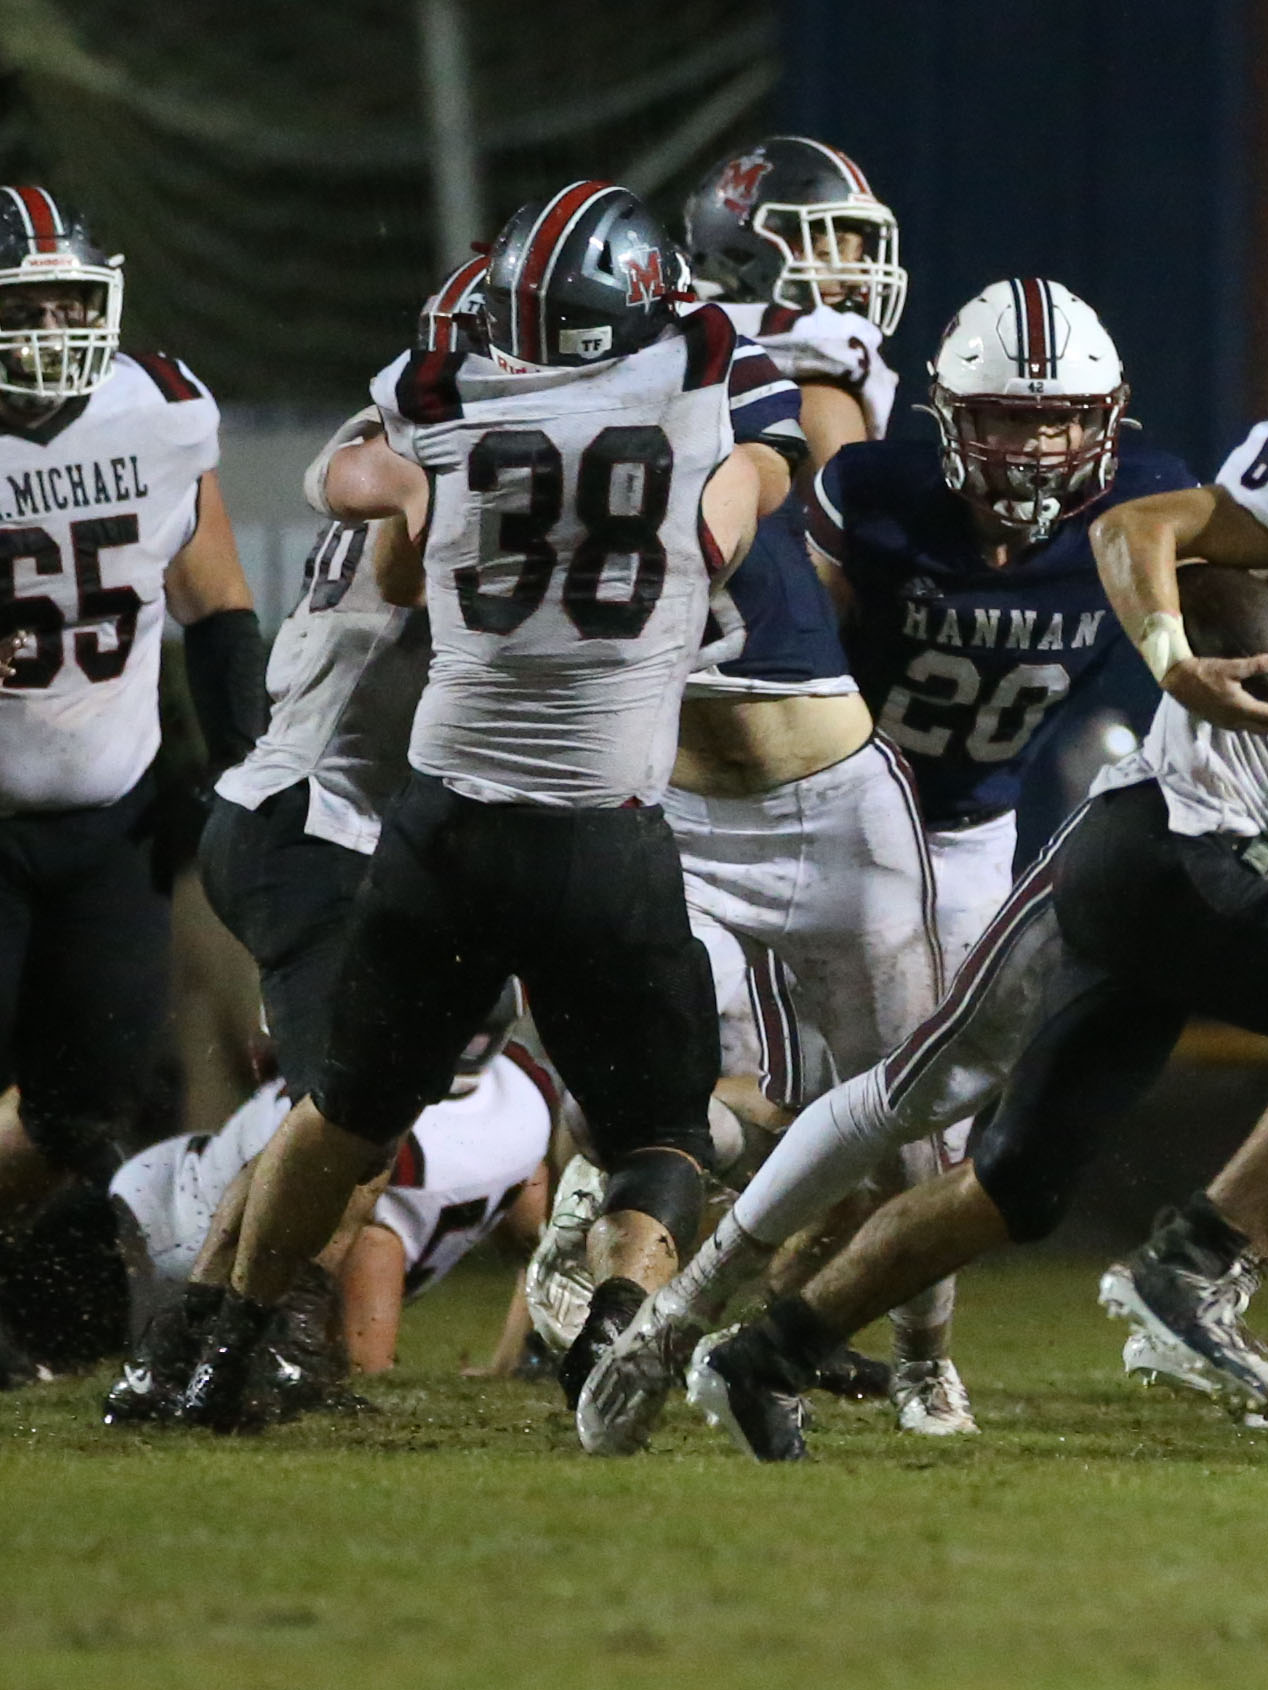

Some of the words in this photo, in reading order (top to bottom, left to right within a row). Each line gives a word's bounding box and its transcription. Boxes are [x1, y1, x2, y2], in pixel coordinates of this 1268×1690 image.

[580, 338, 603, 353] TF
[1027, 381, 1045, 394] 42
[0, 455, 149, 520] .MICHAEL
[453, 424, 675, 640] 38
[0, 512, 141, 690] 65
[902, 600, 1107, 650] HANNAN
[876, 649, 1072, 763] 20
